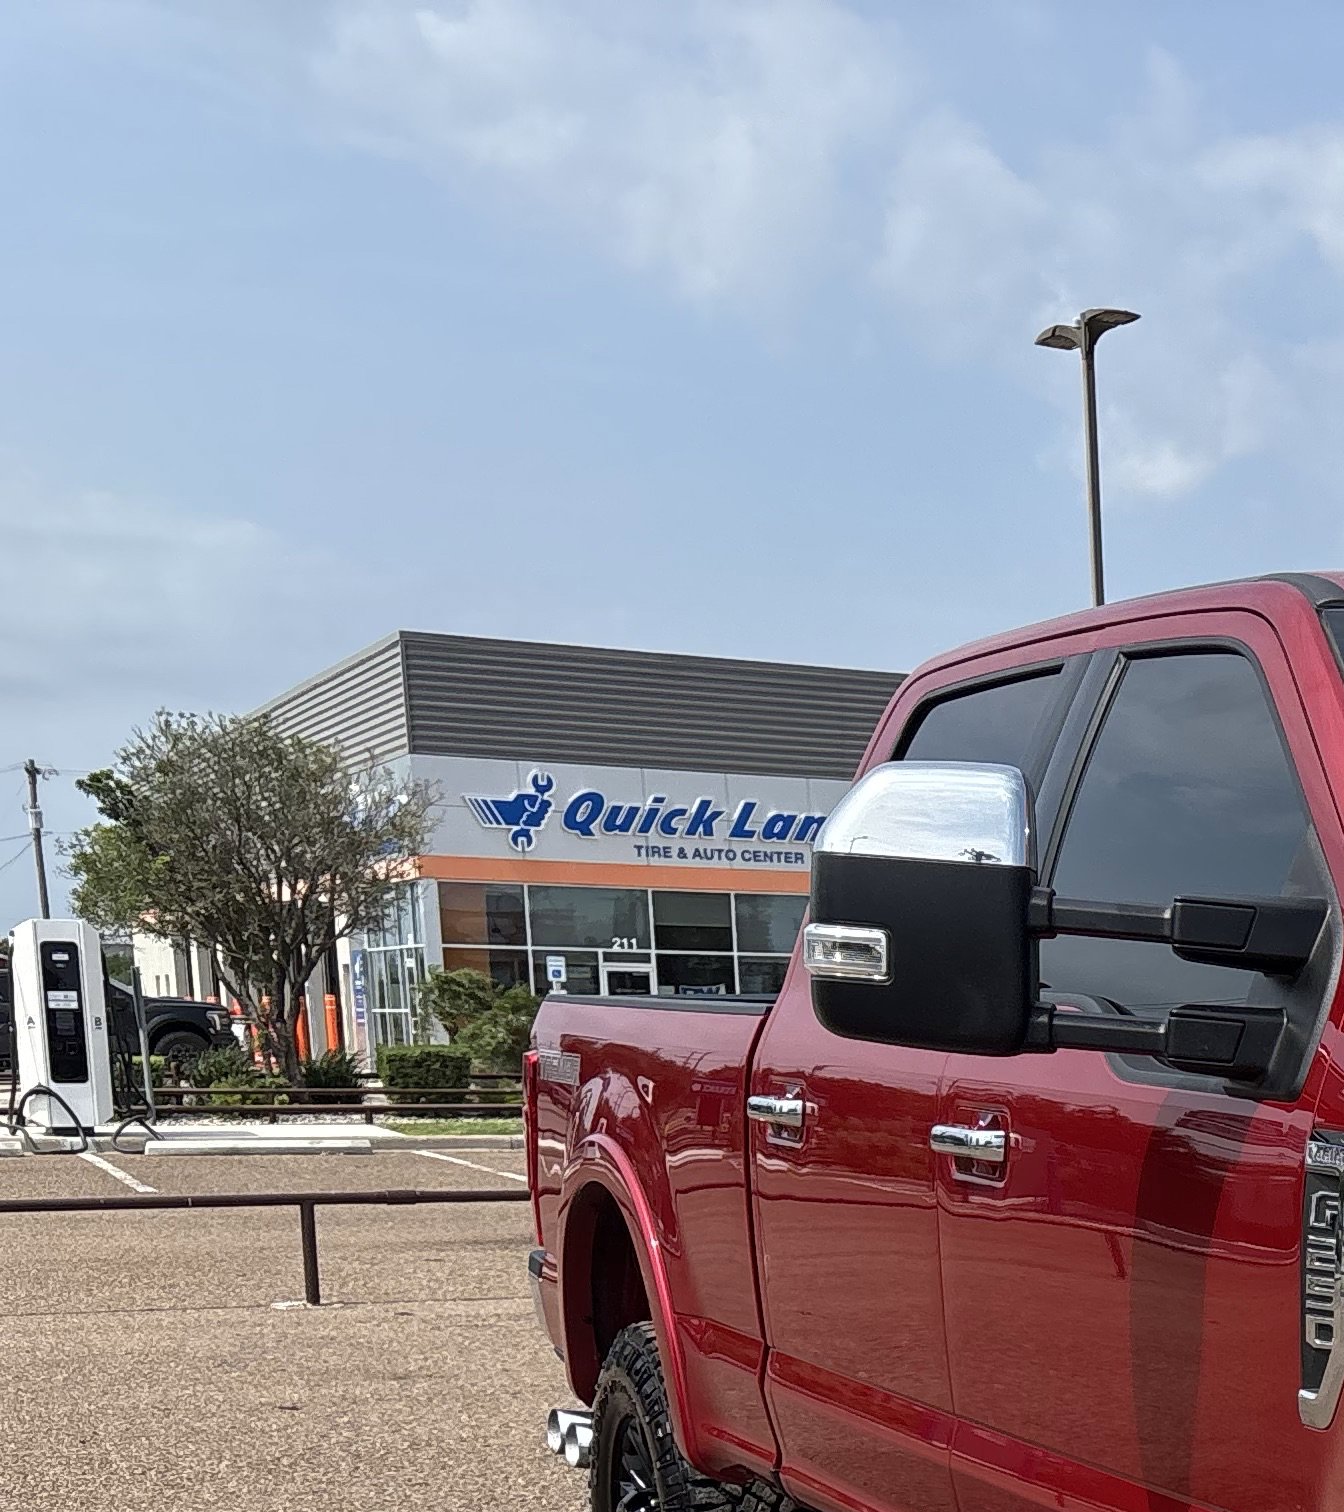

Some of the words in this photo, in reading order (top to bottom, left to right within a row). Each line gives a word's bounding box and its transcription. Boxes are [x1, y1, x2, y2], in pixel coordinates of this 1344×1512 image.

[562, 790, 727, 839] Quick
[728, 801, 828, 843] Lan
[633, 844, 673, 859] TIRE
[677, 847, 689, 860] &
[691, 848, 737, 862] AUTO
[740, 850, 805, 865] CENTER
[611, 936, 638, 951] 211
[26, 1015, 35, 1026] A
[94, 1016, 102, 1027] B
